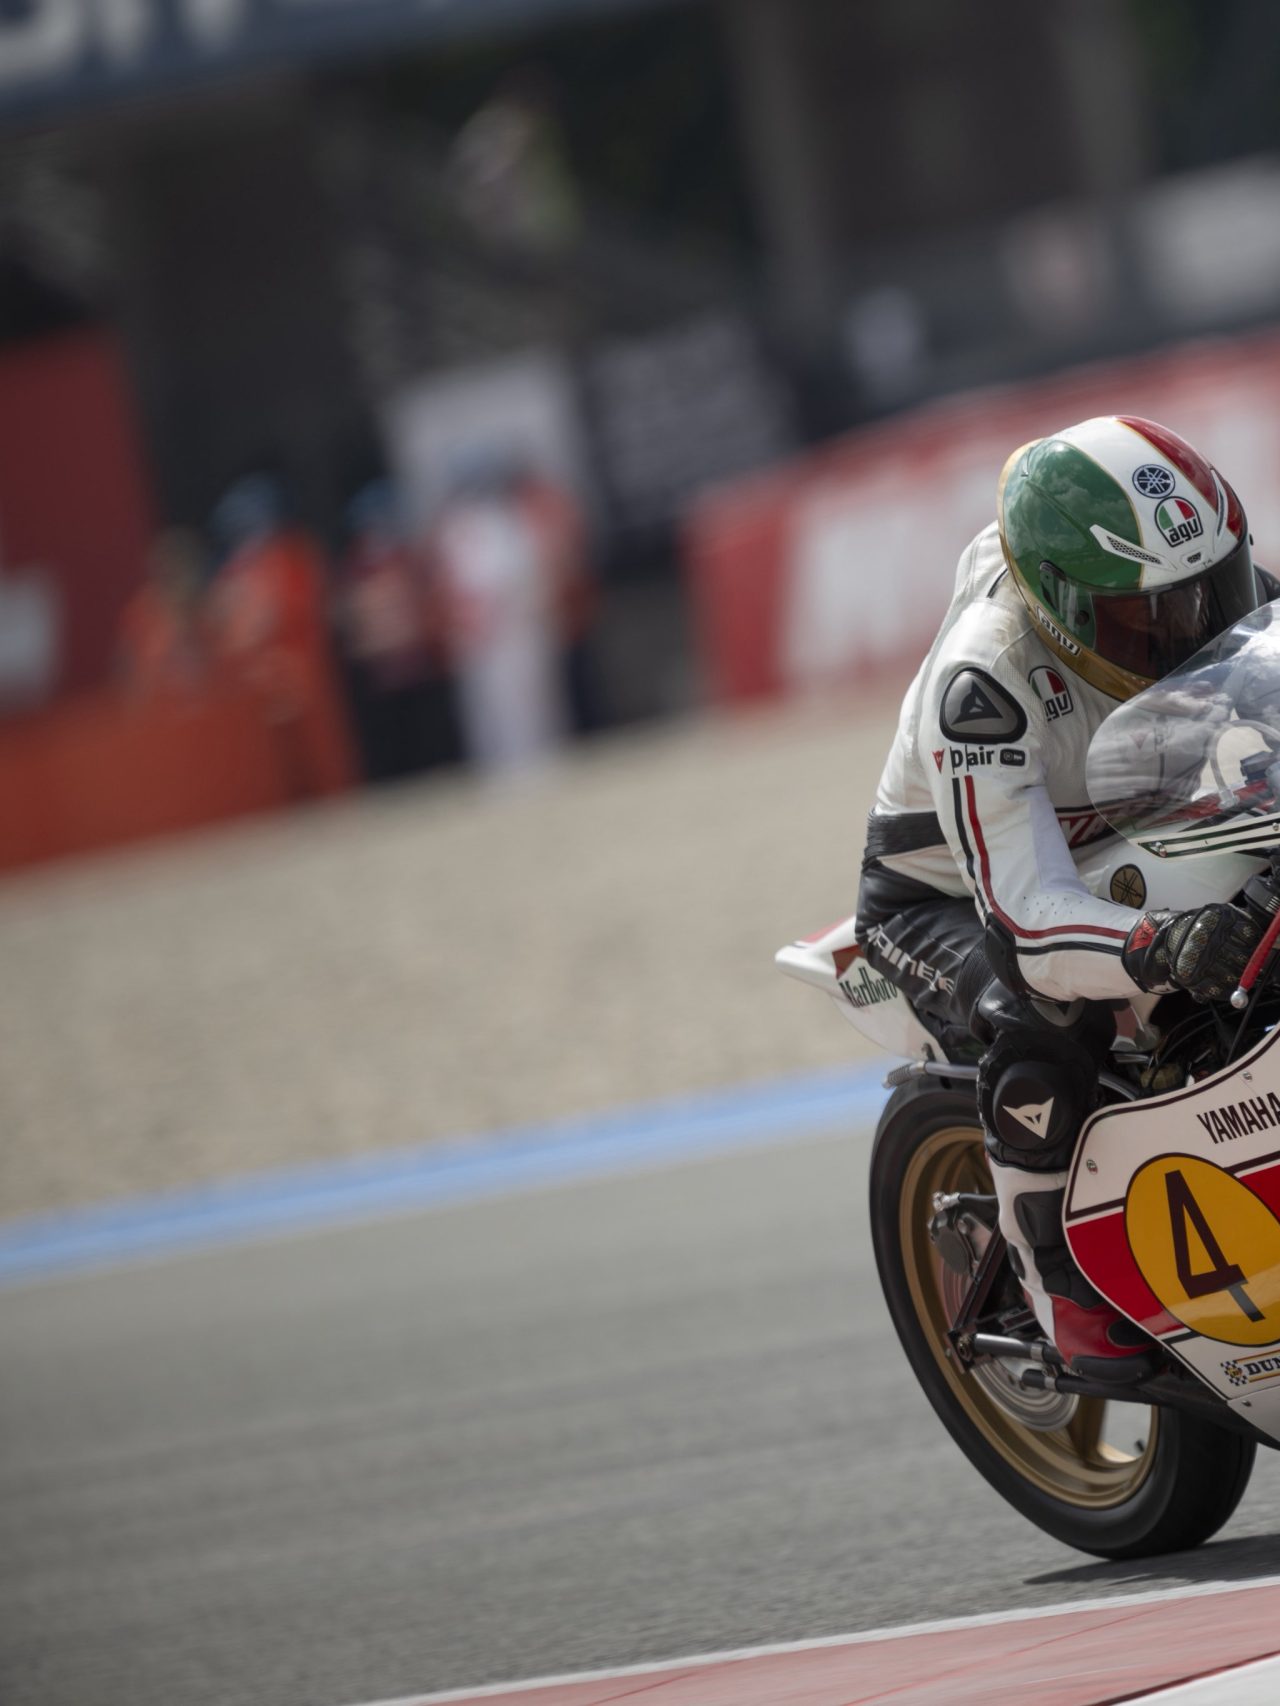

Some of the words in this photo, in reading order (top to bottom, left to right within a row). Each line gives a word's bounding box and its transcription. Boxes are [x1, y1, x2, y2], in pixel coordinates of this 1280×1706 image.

[1169, 518, 1199, 542] agv
[1044, 693, 1069, 721] gv
[1164, 1170, 1266, 1322] 4
